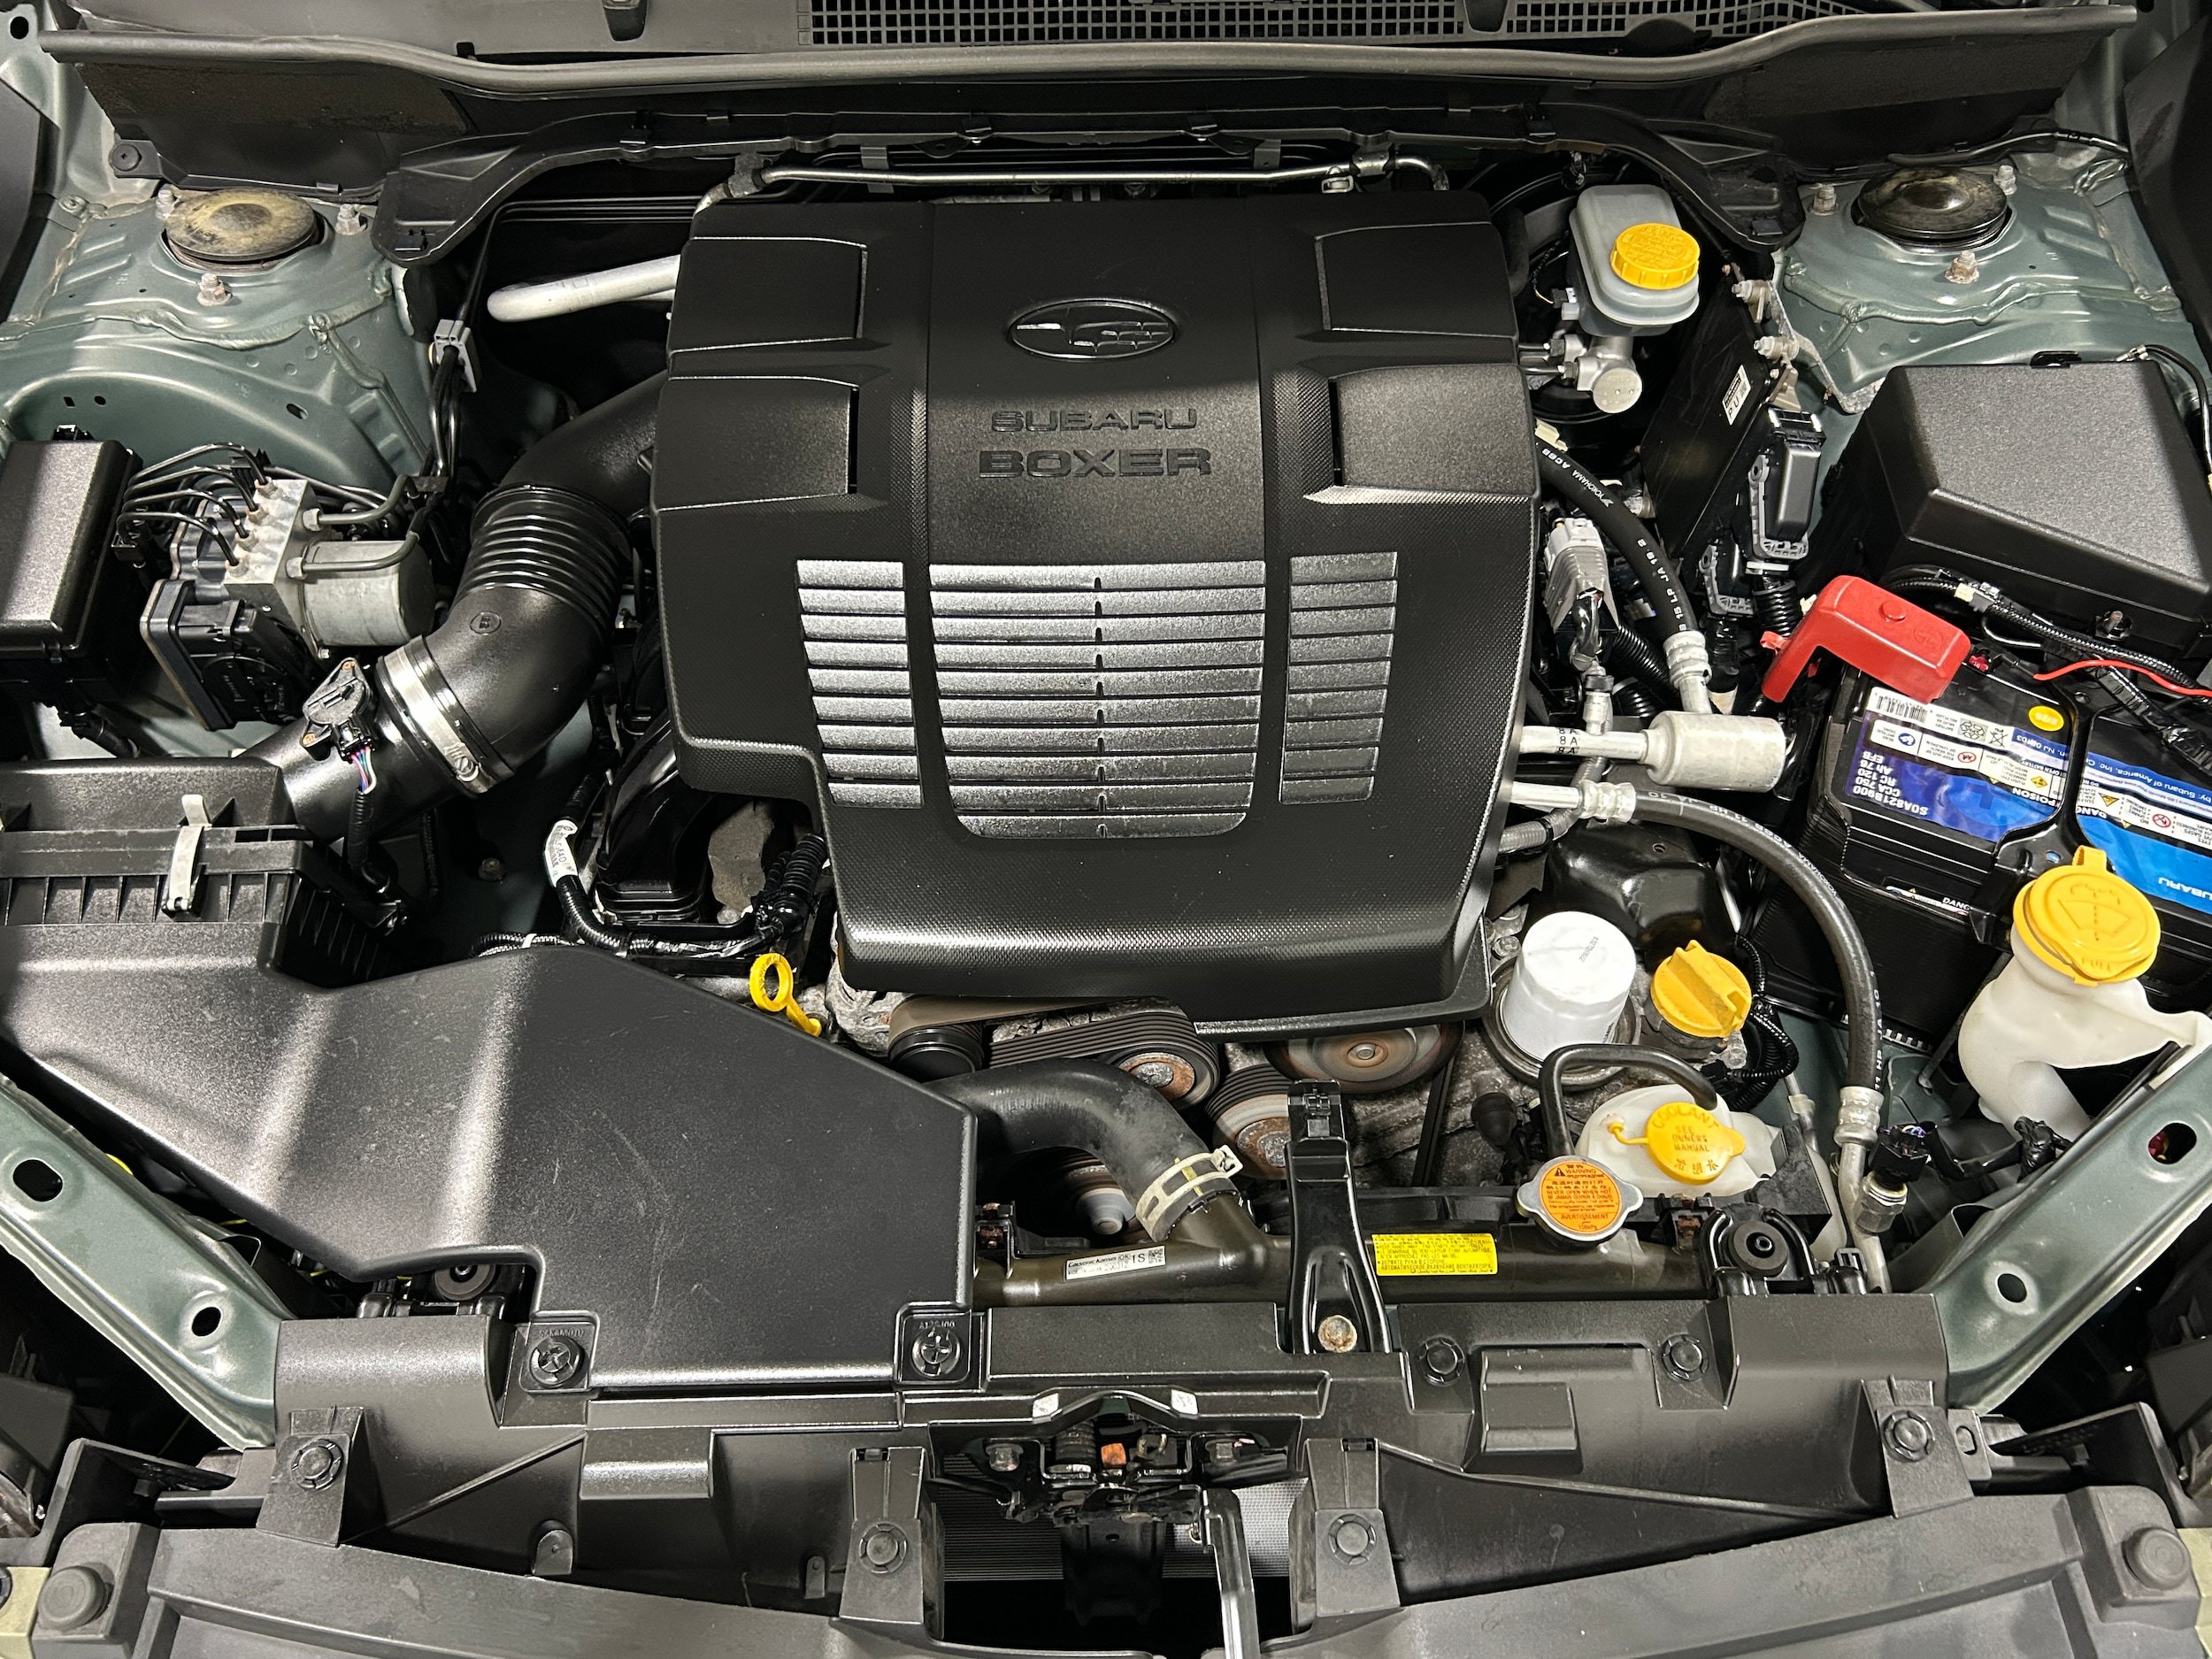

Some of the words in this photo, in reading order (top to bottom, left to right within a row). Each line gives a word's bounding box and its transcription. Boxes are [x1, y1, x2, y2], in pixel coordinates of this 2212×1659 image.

[992, 407, 1197, 433] SUBARU
[979, 447, 1212, 479] BOXER
[1571, 469, 1605, 500] YOKOHAMA
[1656, 566, 1670, 582] JA
[2042, 745, 2055, 754] NJ
[1862, 750, 1885, 764] EFB
[1860, 759, 1876, 771] 76
[1876, 764, 1893, 776] Ah
[1858, 768, 1878, 780] 120
[1879, 775, 1897, 787] RC
[1855, 777, 1877, 790] 750
[2154, 779, 2163, 787] of
[1878, 784, 1901, 797] CCA
[2012, 787, 2057, 807] POISON
[2164, 782, 2196, 799] Subaru
[2158, 877, 2212, 902] UBARU
[1651, 1104, 1720, 1129] COOLANT
